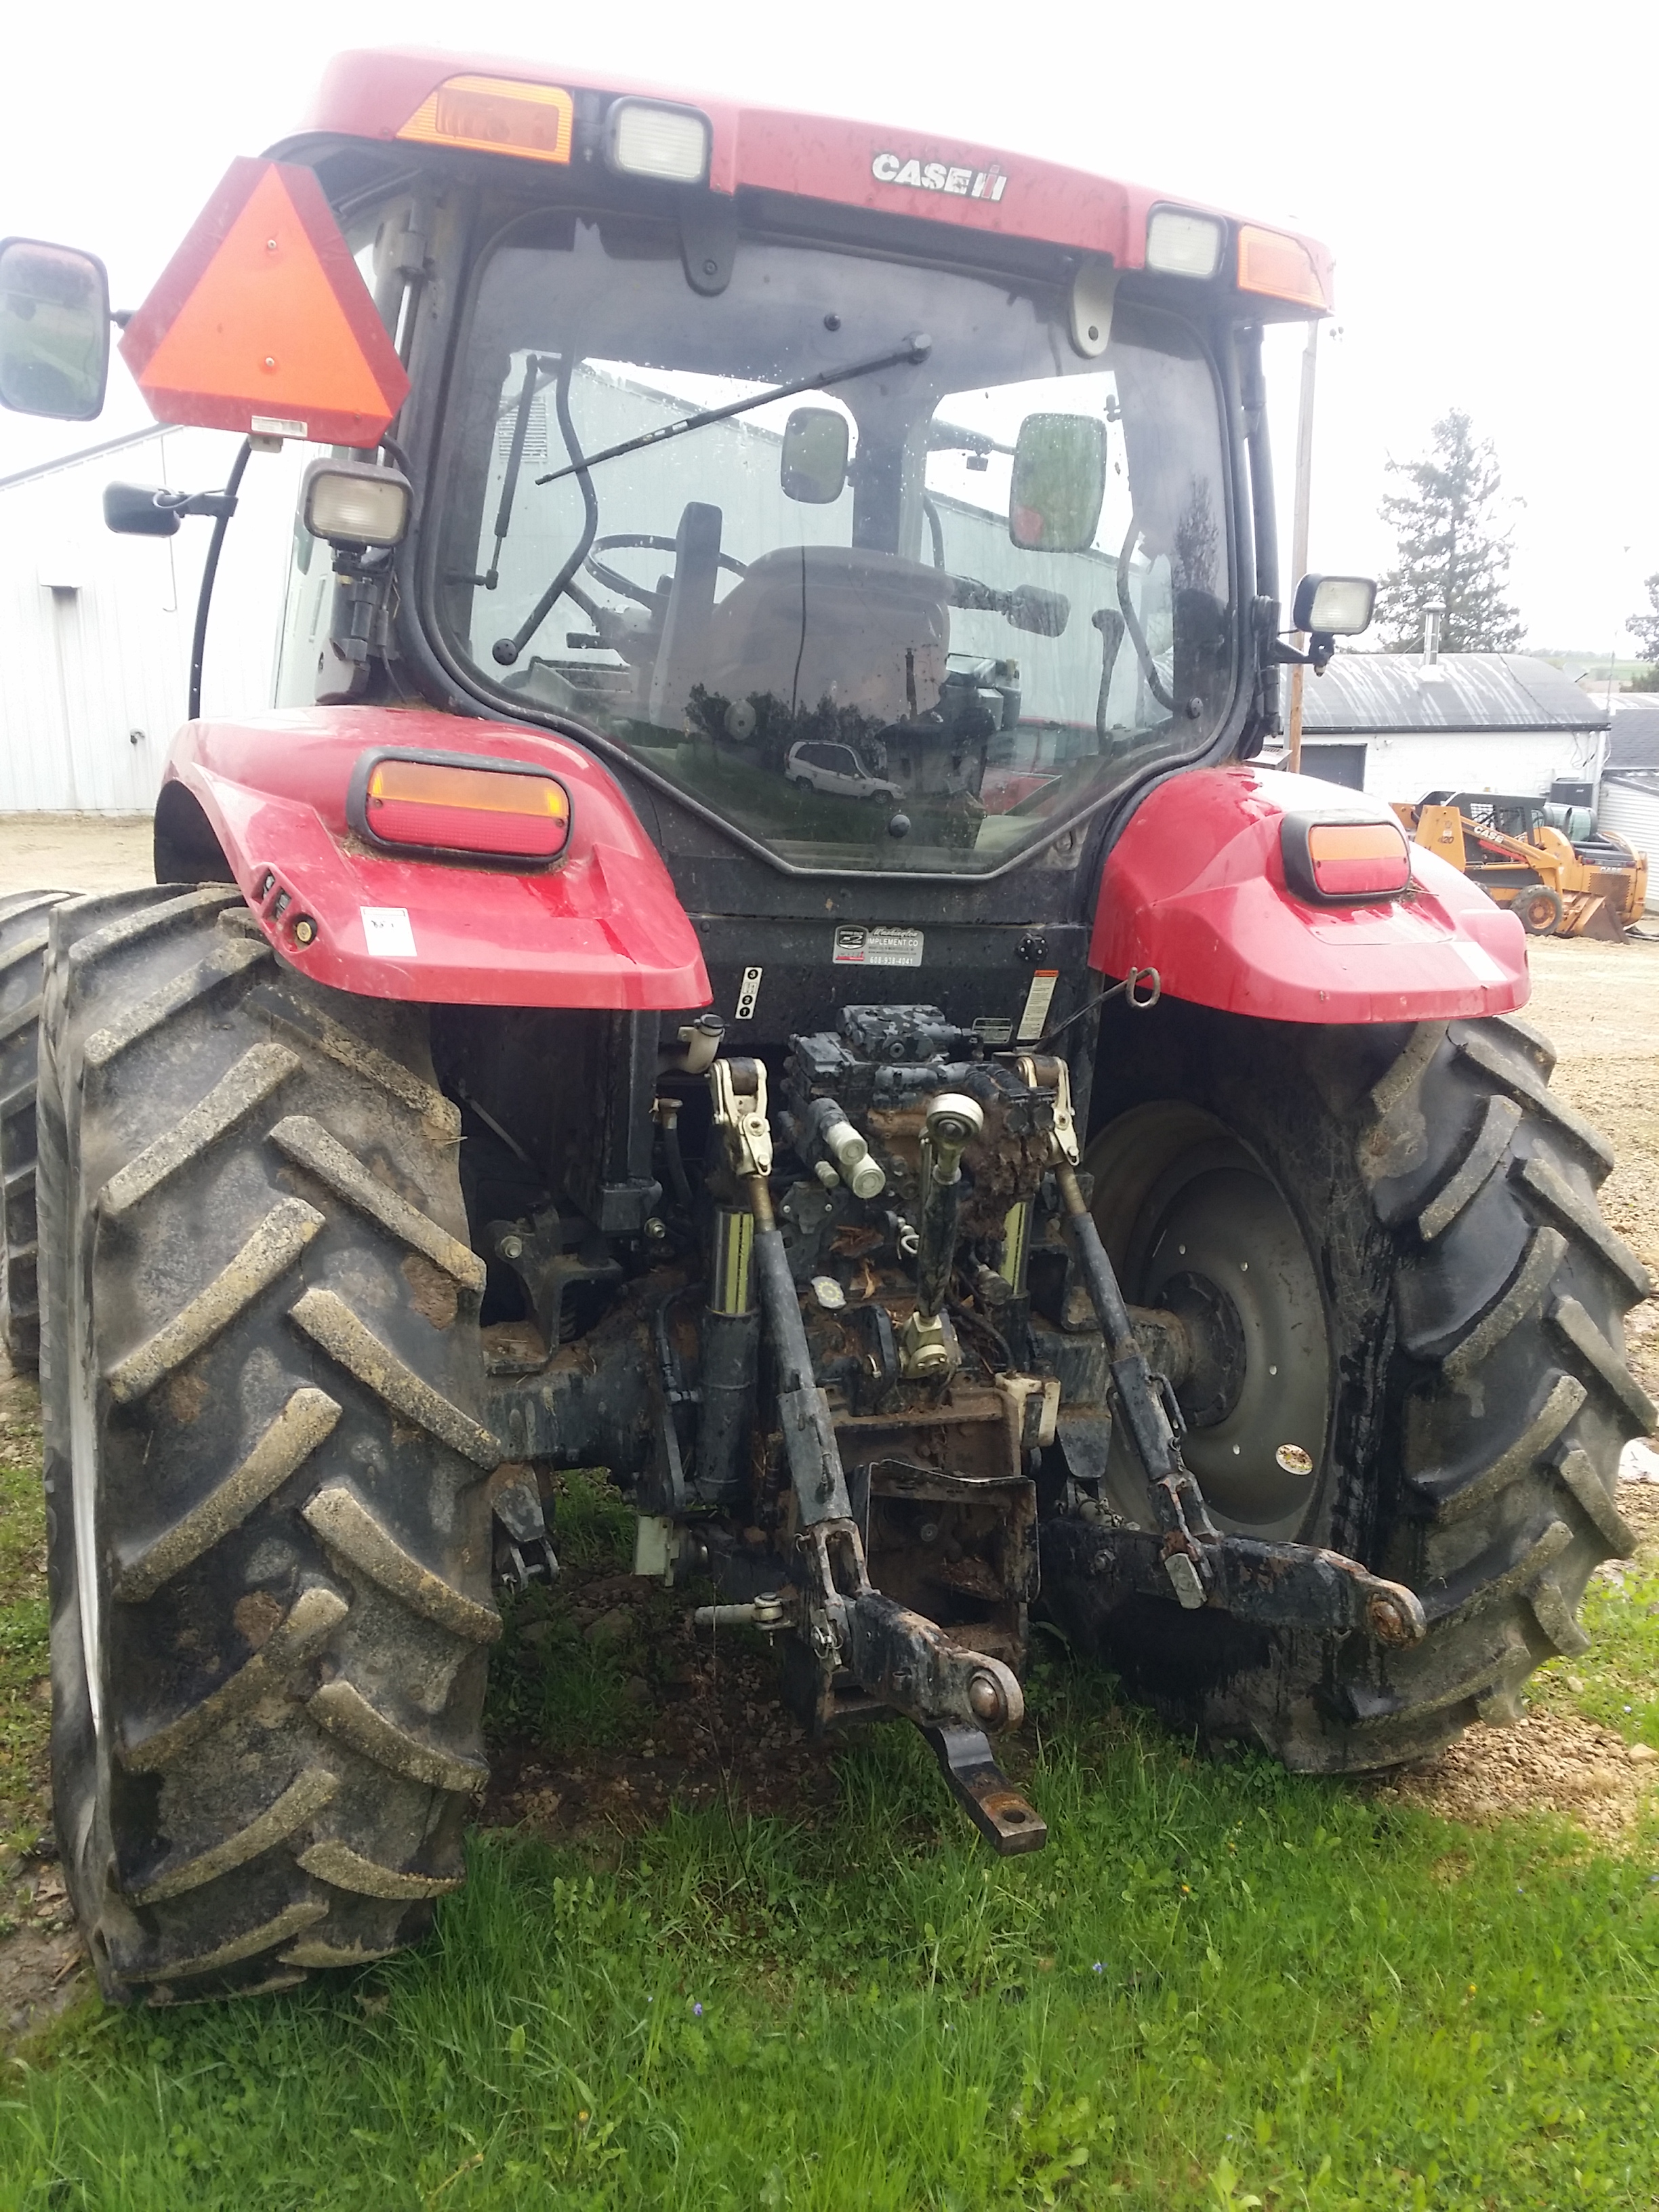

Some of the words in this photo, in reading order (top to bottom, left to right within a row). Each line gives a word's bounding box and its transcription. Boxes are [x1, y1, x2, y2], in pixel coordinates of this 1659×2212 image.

[872, 153, 972, 194] CASE
[1473, 825, 1504, 844] CASE
[872, 928, 918, 938] Washington
[867, 937, 907, 946] IMPLEMENT
[869, 956, 913, 965] 608-938-4041
